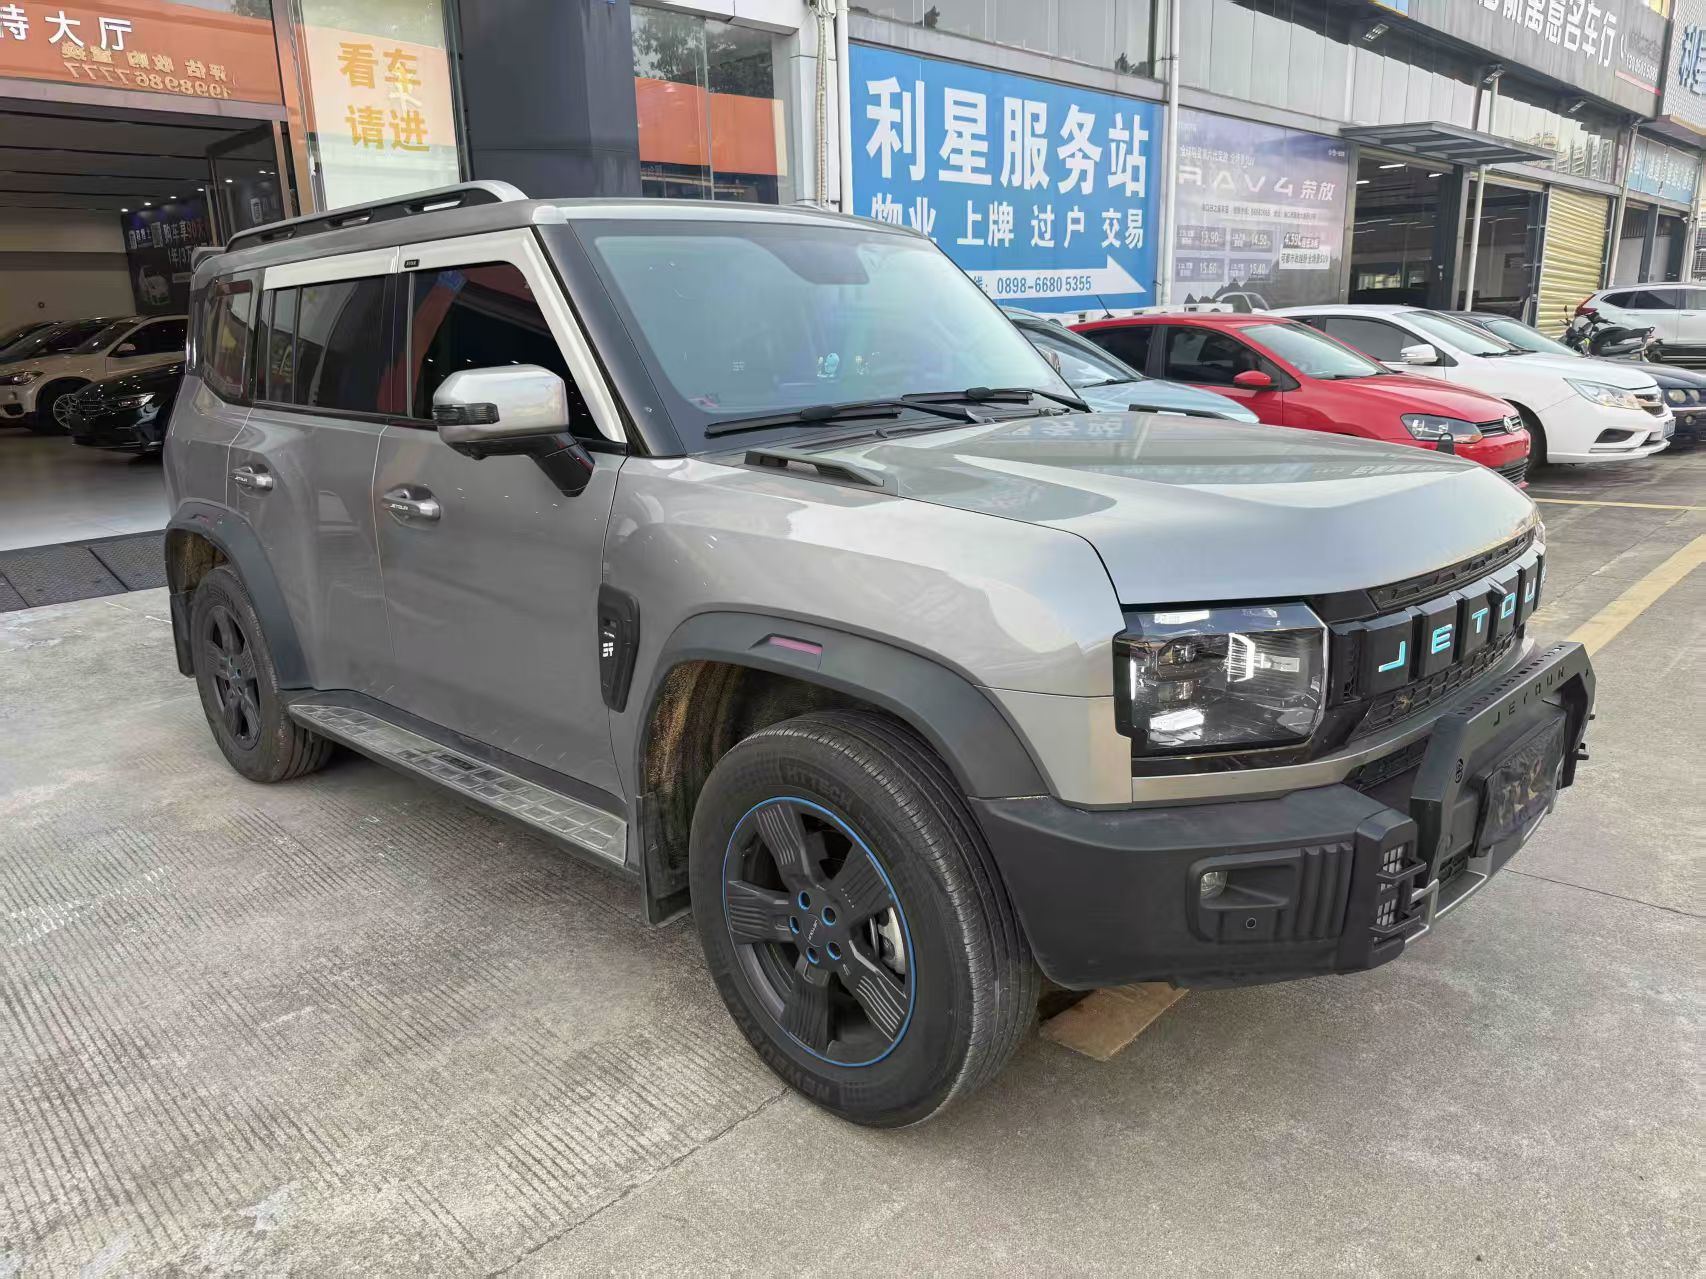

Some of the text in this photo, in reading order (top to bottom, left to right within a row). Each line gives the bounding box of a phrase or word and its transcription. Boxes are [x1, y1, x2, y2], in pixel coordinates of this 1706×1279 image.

[337, 41, 423, 91] 看车
[345, 103, 431, 153] 请进
[866, 76, 1149, 198] 利星服务站
[1300, 180, 1336, 201] 荣放
[871, 192, 1144, 249] 物业 上牌 过户 交易
[997, 275, 1063, 294] 0898-6680
[1065, 275, 1092, 292] 5355
[1378, 575, 1541, 673] JETOU
